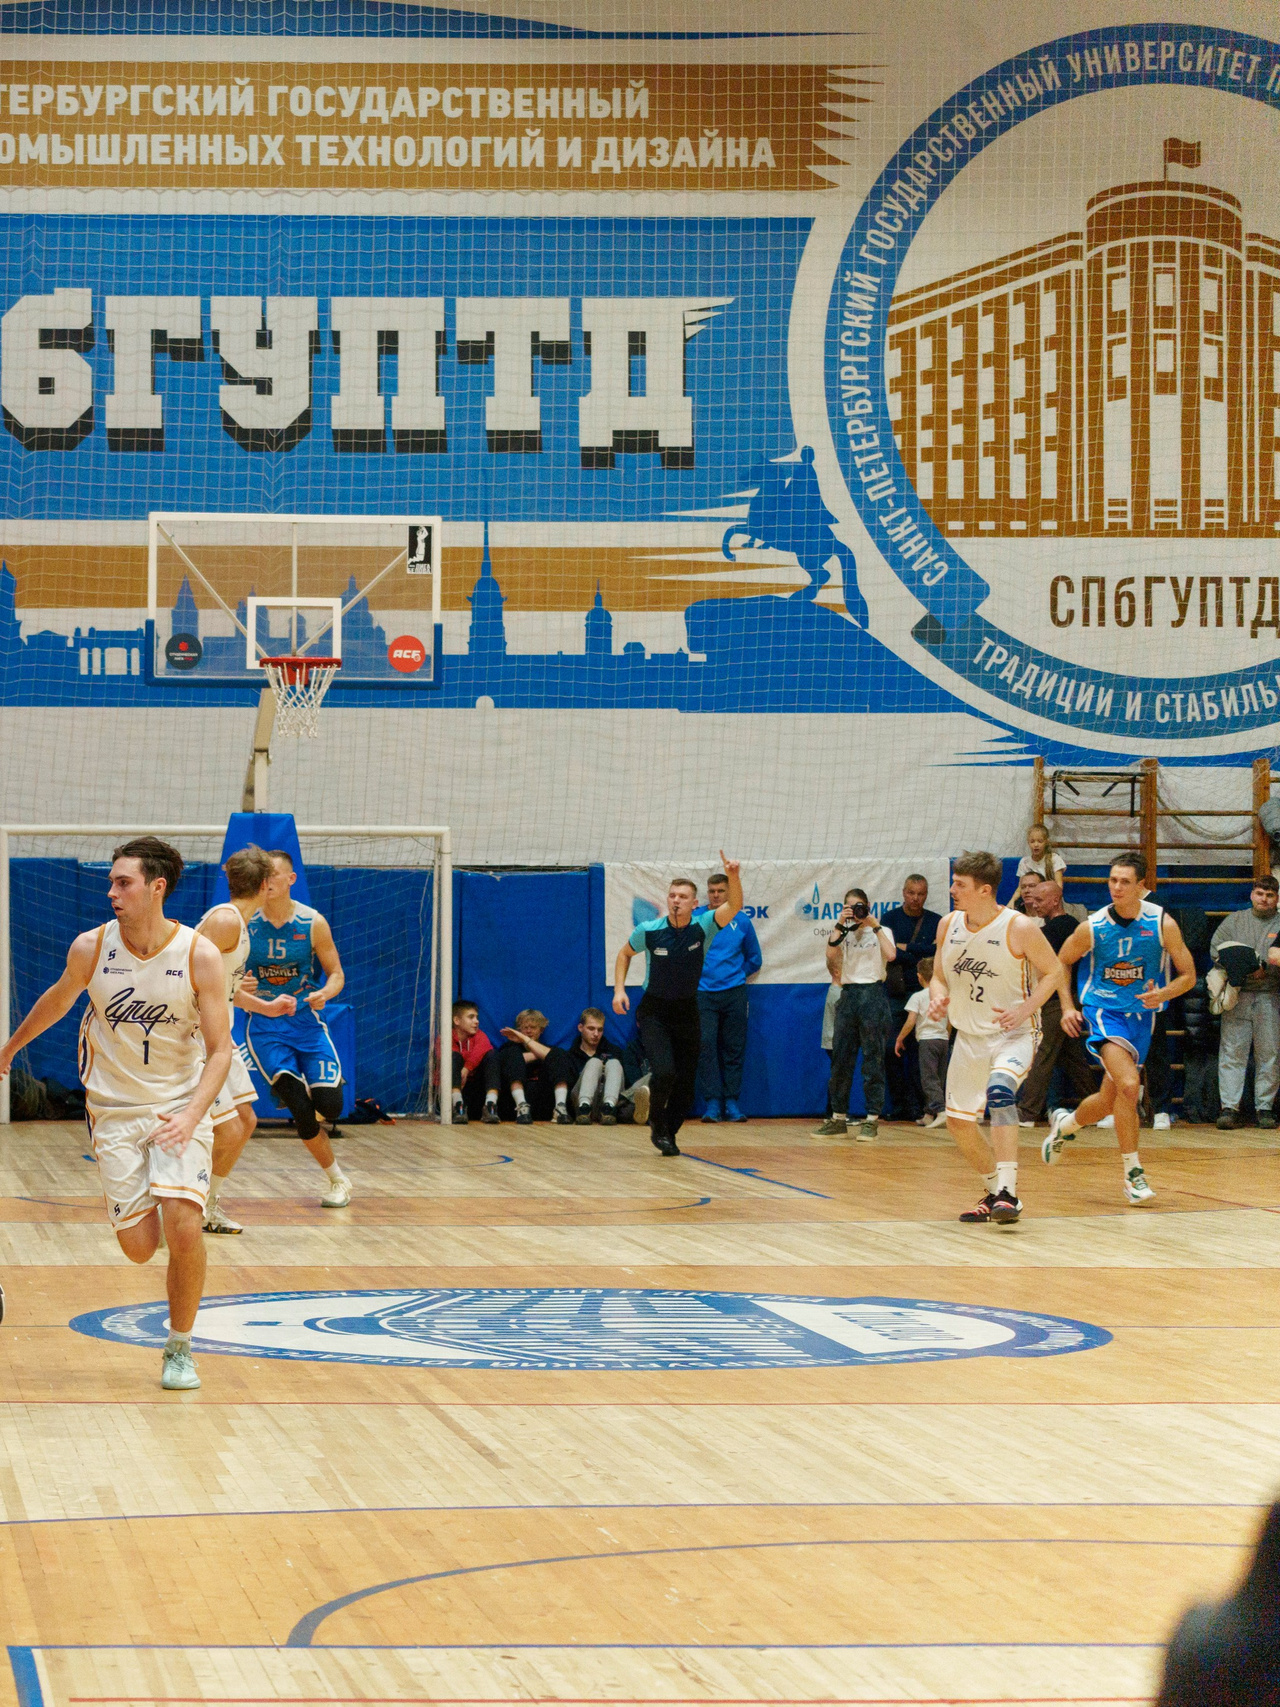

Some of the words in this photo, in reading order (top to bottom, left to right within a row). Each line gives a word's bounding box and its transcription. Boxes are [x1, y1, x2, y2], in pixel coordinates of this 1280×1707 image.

[1067, 40, 1262, 84] УНИВЕРСИТЕТ
[268, 78, 650, 124] ГОСУДАРСТВЕННЫЙ
[294, 128, 541, 168] ТЕХНОЛОГИЙ
[558, 136, 582, 168] И
[591, 128, 776, 174] ДИЗАЙНА
[858, 54, 1062, 267] ГОСУДАРСТВЕННЫЙ
[840, 270, 949, 587] САНКТ-ПЕТЕРБУРГСКИЙ
[972, 635, 1115, 719] ТРАДИЦИИ
[1125, 691, 1141, 721] И
[267, 938, 287, 960] 15
[1117, 936, 1133, 958] 17
[143, 1040, 150, 1065] 1
[319, 1060, 337, 1080] 15
